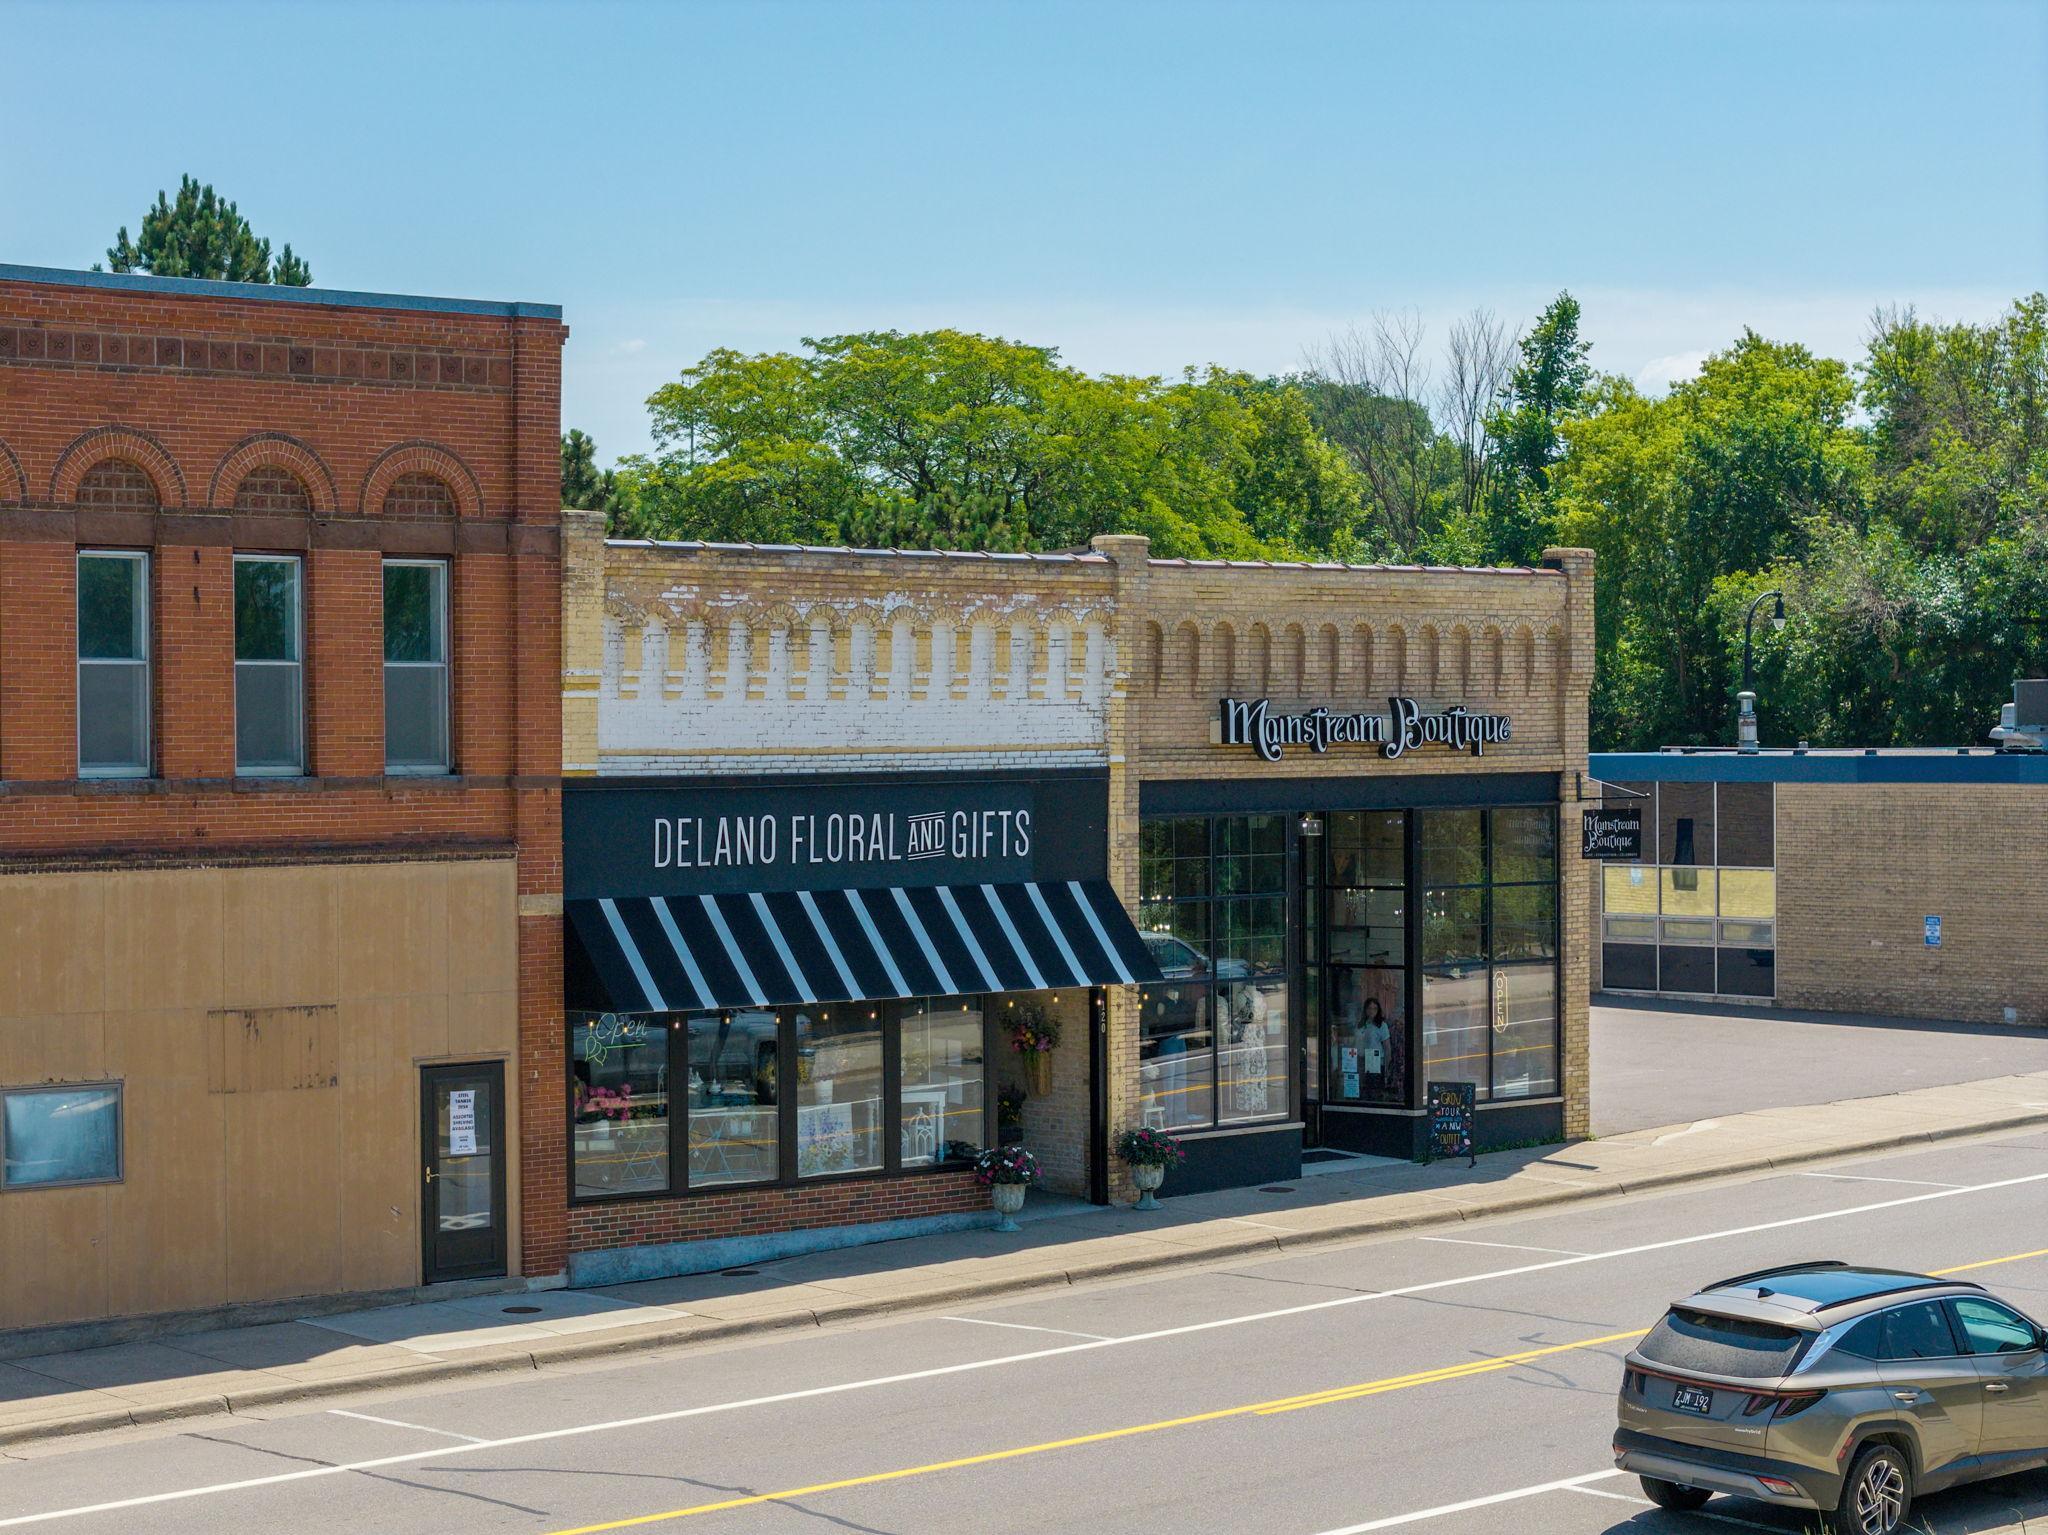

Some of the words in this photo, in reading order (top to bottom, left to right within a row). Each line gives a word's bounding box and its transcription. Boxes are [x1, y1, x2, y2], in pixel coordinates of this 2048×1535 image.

[1221, 698, 1385, 762] Mainstream
[1380, 697, 1512, 760] Boutique
[654, 814, 778, 868] DELANO
[791, 813, 902, 864] FLORAL
[908, 818, 946, 853] AND
[951, 809, 1031, 858] GIFTS
[1583, 815, 1640, 836] Mainstream
[1583, 831, 1633, 852] Boutique
[1496, 977, 1505, 1026] OPEN
[595, 1012, 648, 1045] Open
[1442, 1122, 1448, 1130] A
[1675, 1390, 1692, 1405] ZJM
[1693, 1394, 1710, 1409] 192
